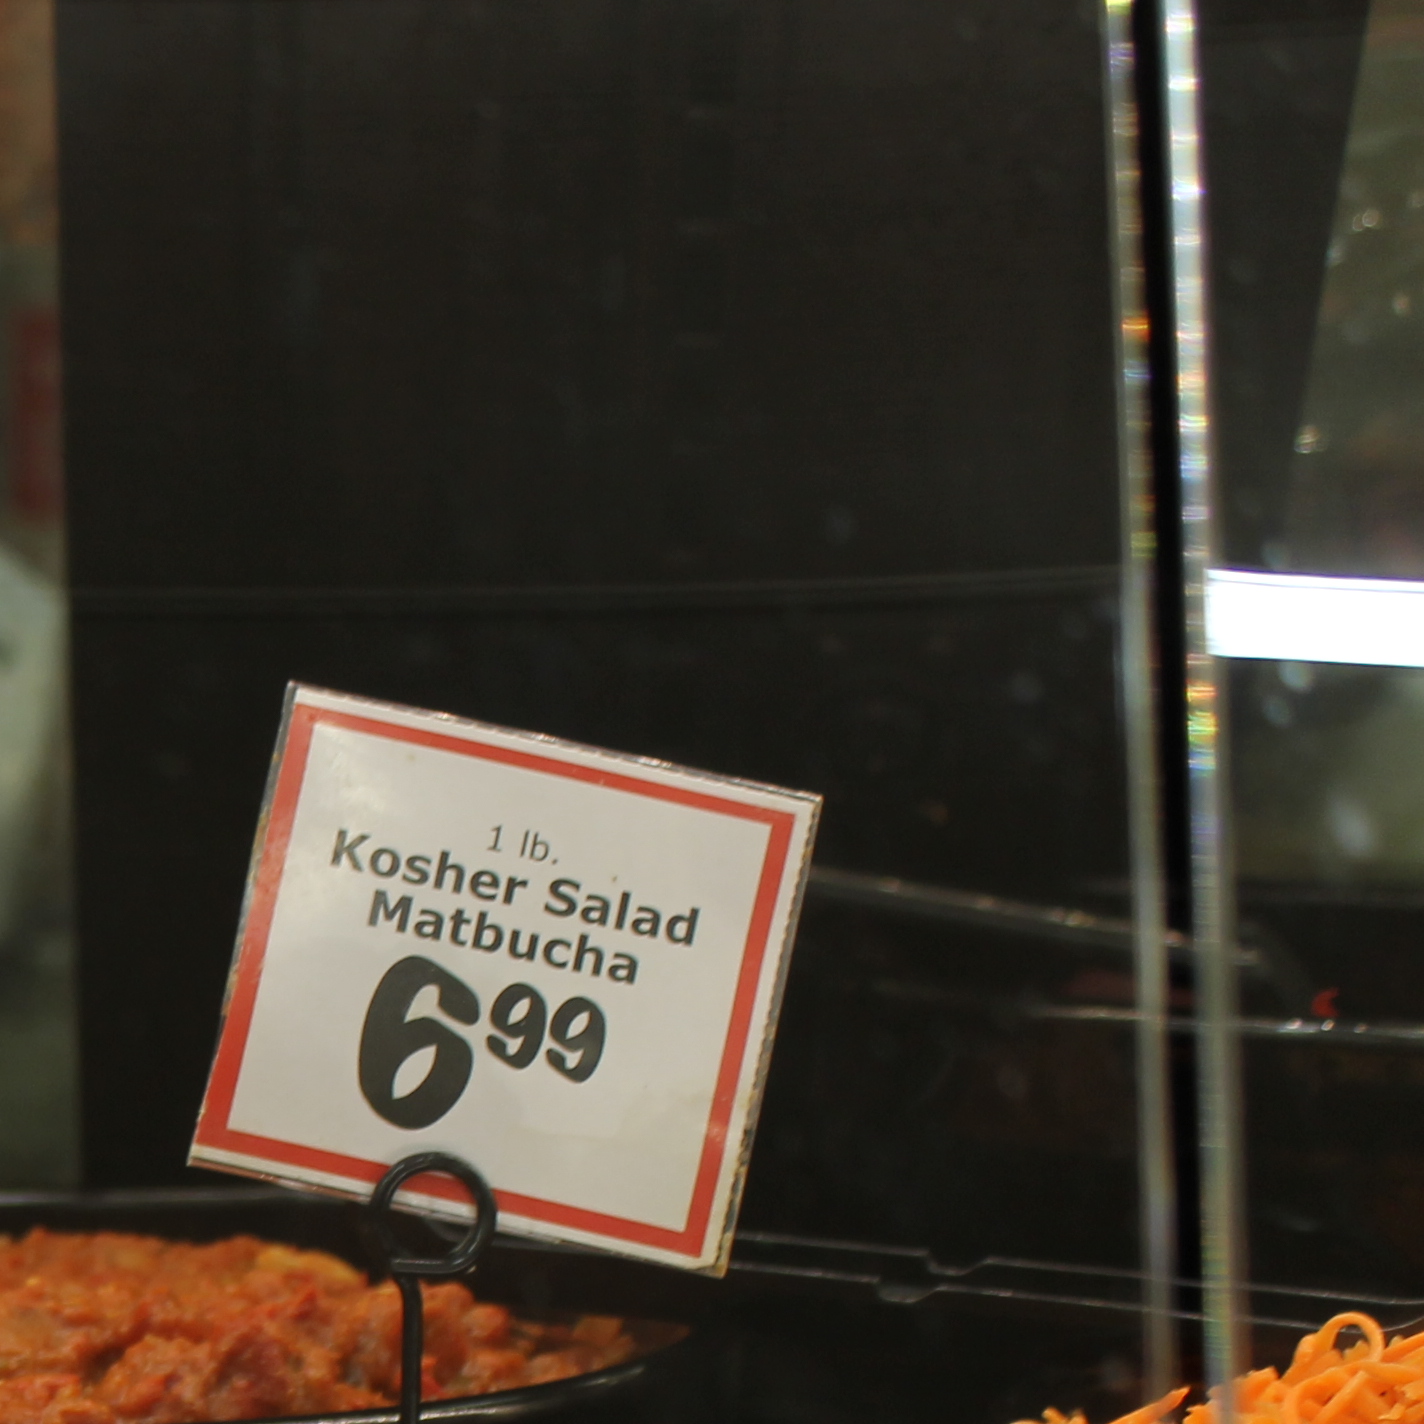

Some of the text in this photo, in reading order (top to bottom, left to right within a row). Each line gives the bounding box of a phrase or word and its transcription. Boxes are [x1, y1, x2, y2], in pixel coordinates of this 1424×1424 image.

[330, 829, 701, 946] Kosher Salad
[487, 825, 560, 866] 1 lb.
[366, 889, 641, 985] Matbucha
